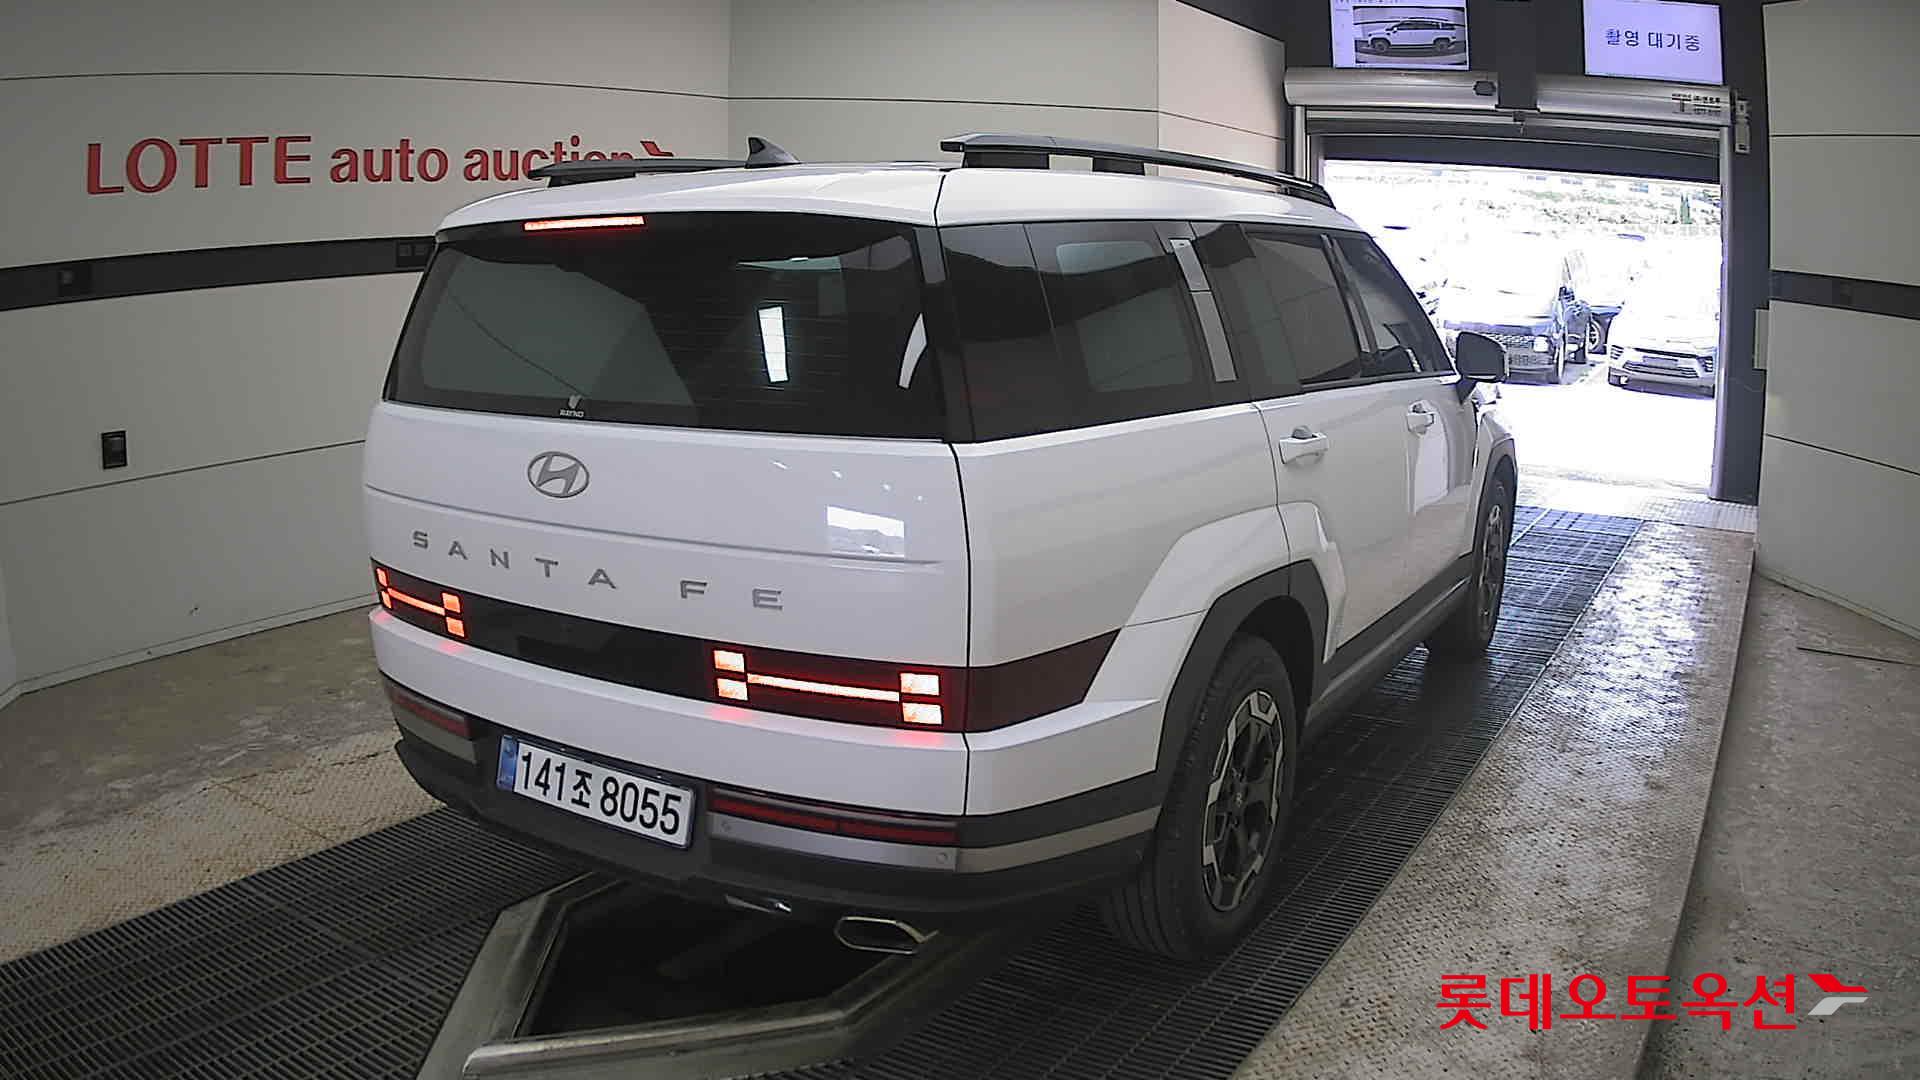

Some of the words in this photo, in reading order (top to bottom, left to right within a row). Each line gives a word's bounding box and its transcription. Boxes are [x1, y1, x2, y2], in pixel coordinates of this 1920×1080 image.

[1648, 31, 1700, 52] 대기중
[87, 136, 311, 194] LOTTE
[330, 138, 449, 183] auto
[412, 530, 617, 590] SANTA
[680, 579, 783, 611] FE
[521, 751, 593, 809] 141조
[599, 775, 683, 836] 8055
